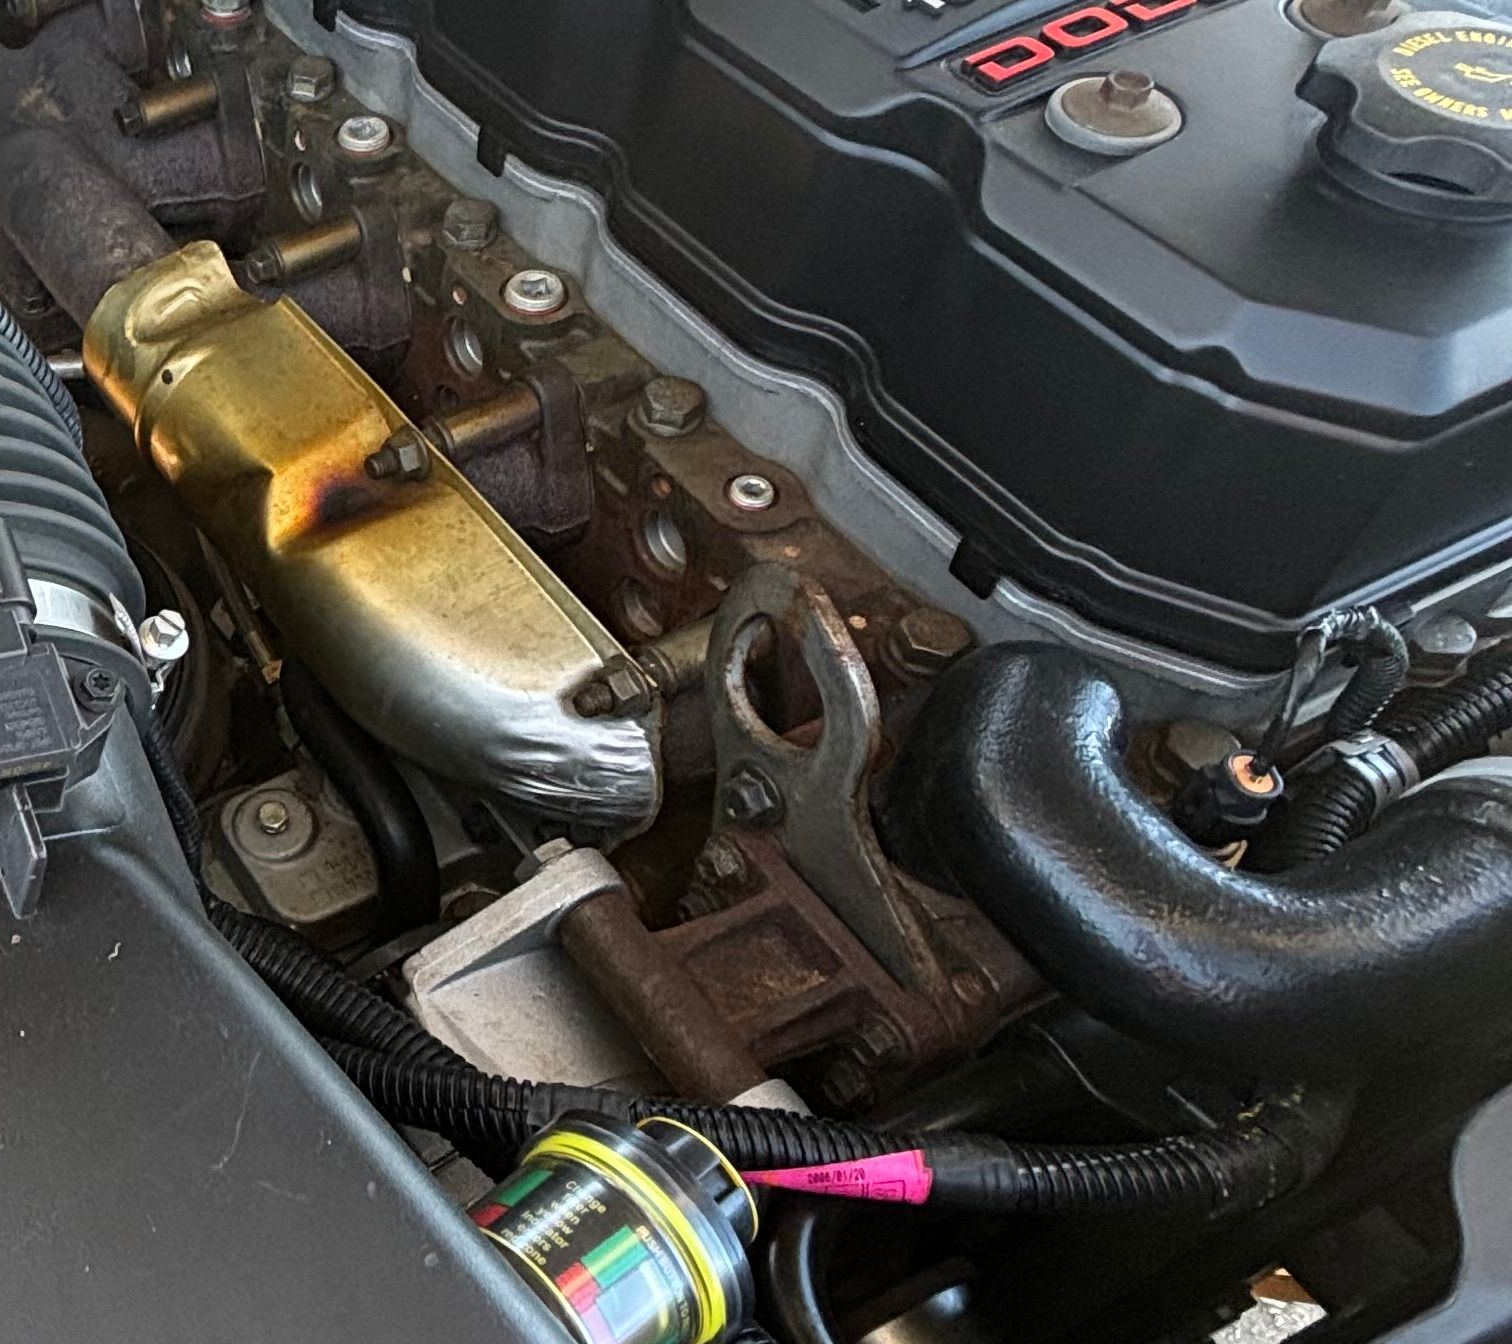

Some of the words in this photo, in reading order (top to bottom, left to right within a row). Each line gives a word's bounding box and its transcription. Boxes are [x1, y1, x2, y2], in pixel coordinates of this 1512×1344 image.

[1392, 31, 1453, 57] DIESEL
[1390, 67, 1422, 88] SEE
[1413, 87, 1489, 119] OWNERS
[549, 1199, 581, 1226] wen
[564, 1178, 608, 1216] Chnge
